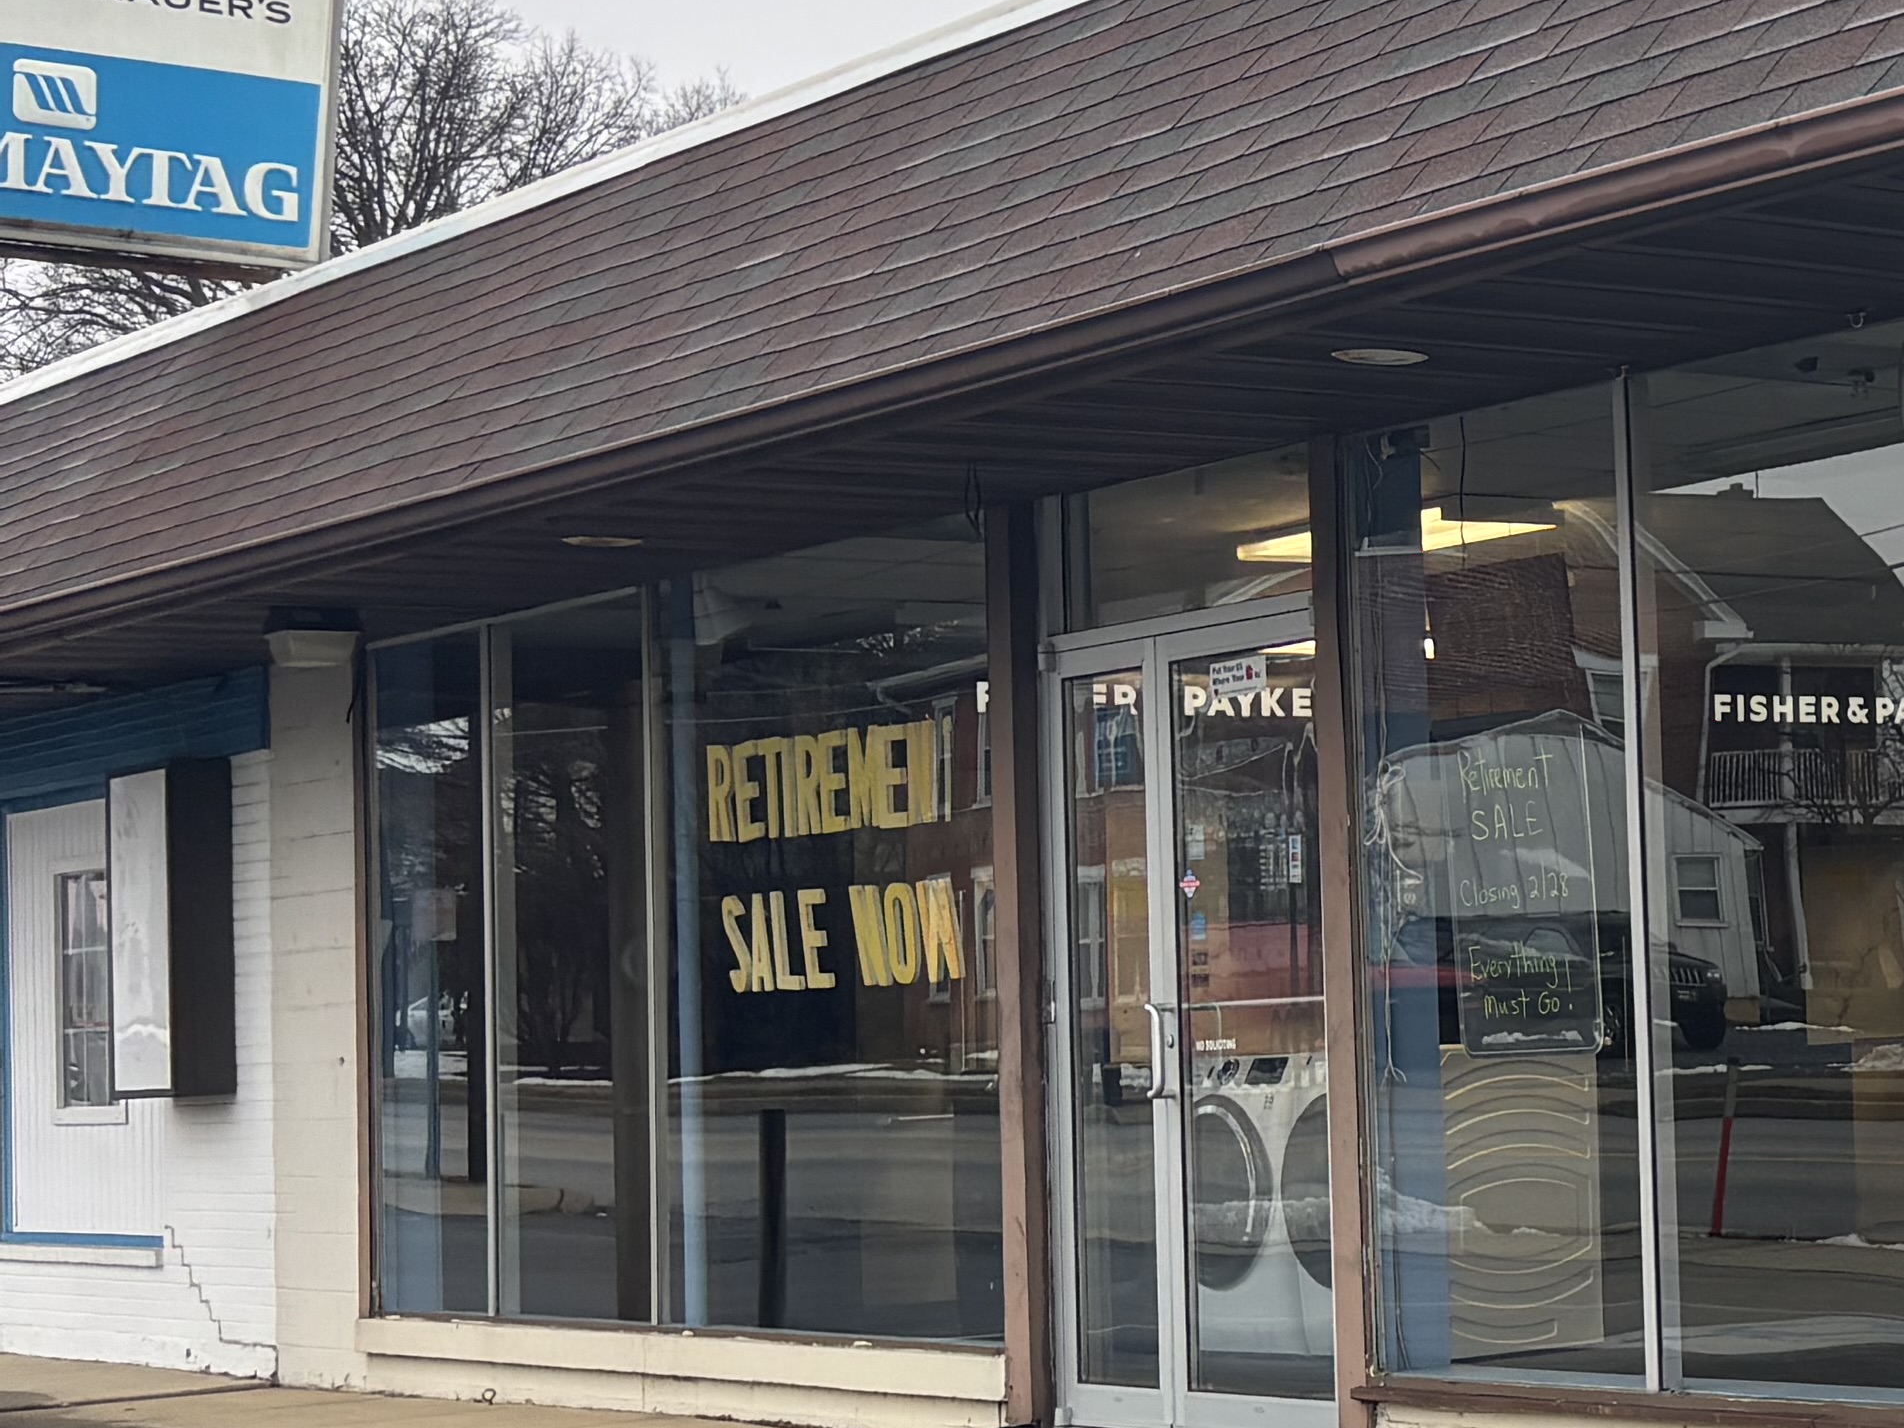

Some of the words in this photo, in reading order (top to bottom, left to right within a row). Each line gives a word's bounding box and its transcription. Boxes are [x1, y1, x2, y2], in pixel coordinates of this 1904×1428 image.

[0, 131, 299, 222] MAYTAG
[1714, 694, 1840, 724] FISHER
[1847, 696, 1869, 724] &
[1457, 744, 1553, 804] Retirement
[1472, 801, 1543, 840] SALE
[1460, 876, 1520, 909] Closing
[1528, 862, 1569, 900] 2/28
[721, 888, 836, 993] SALE
[848, 877, 966, 987] NOW
